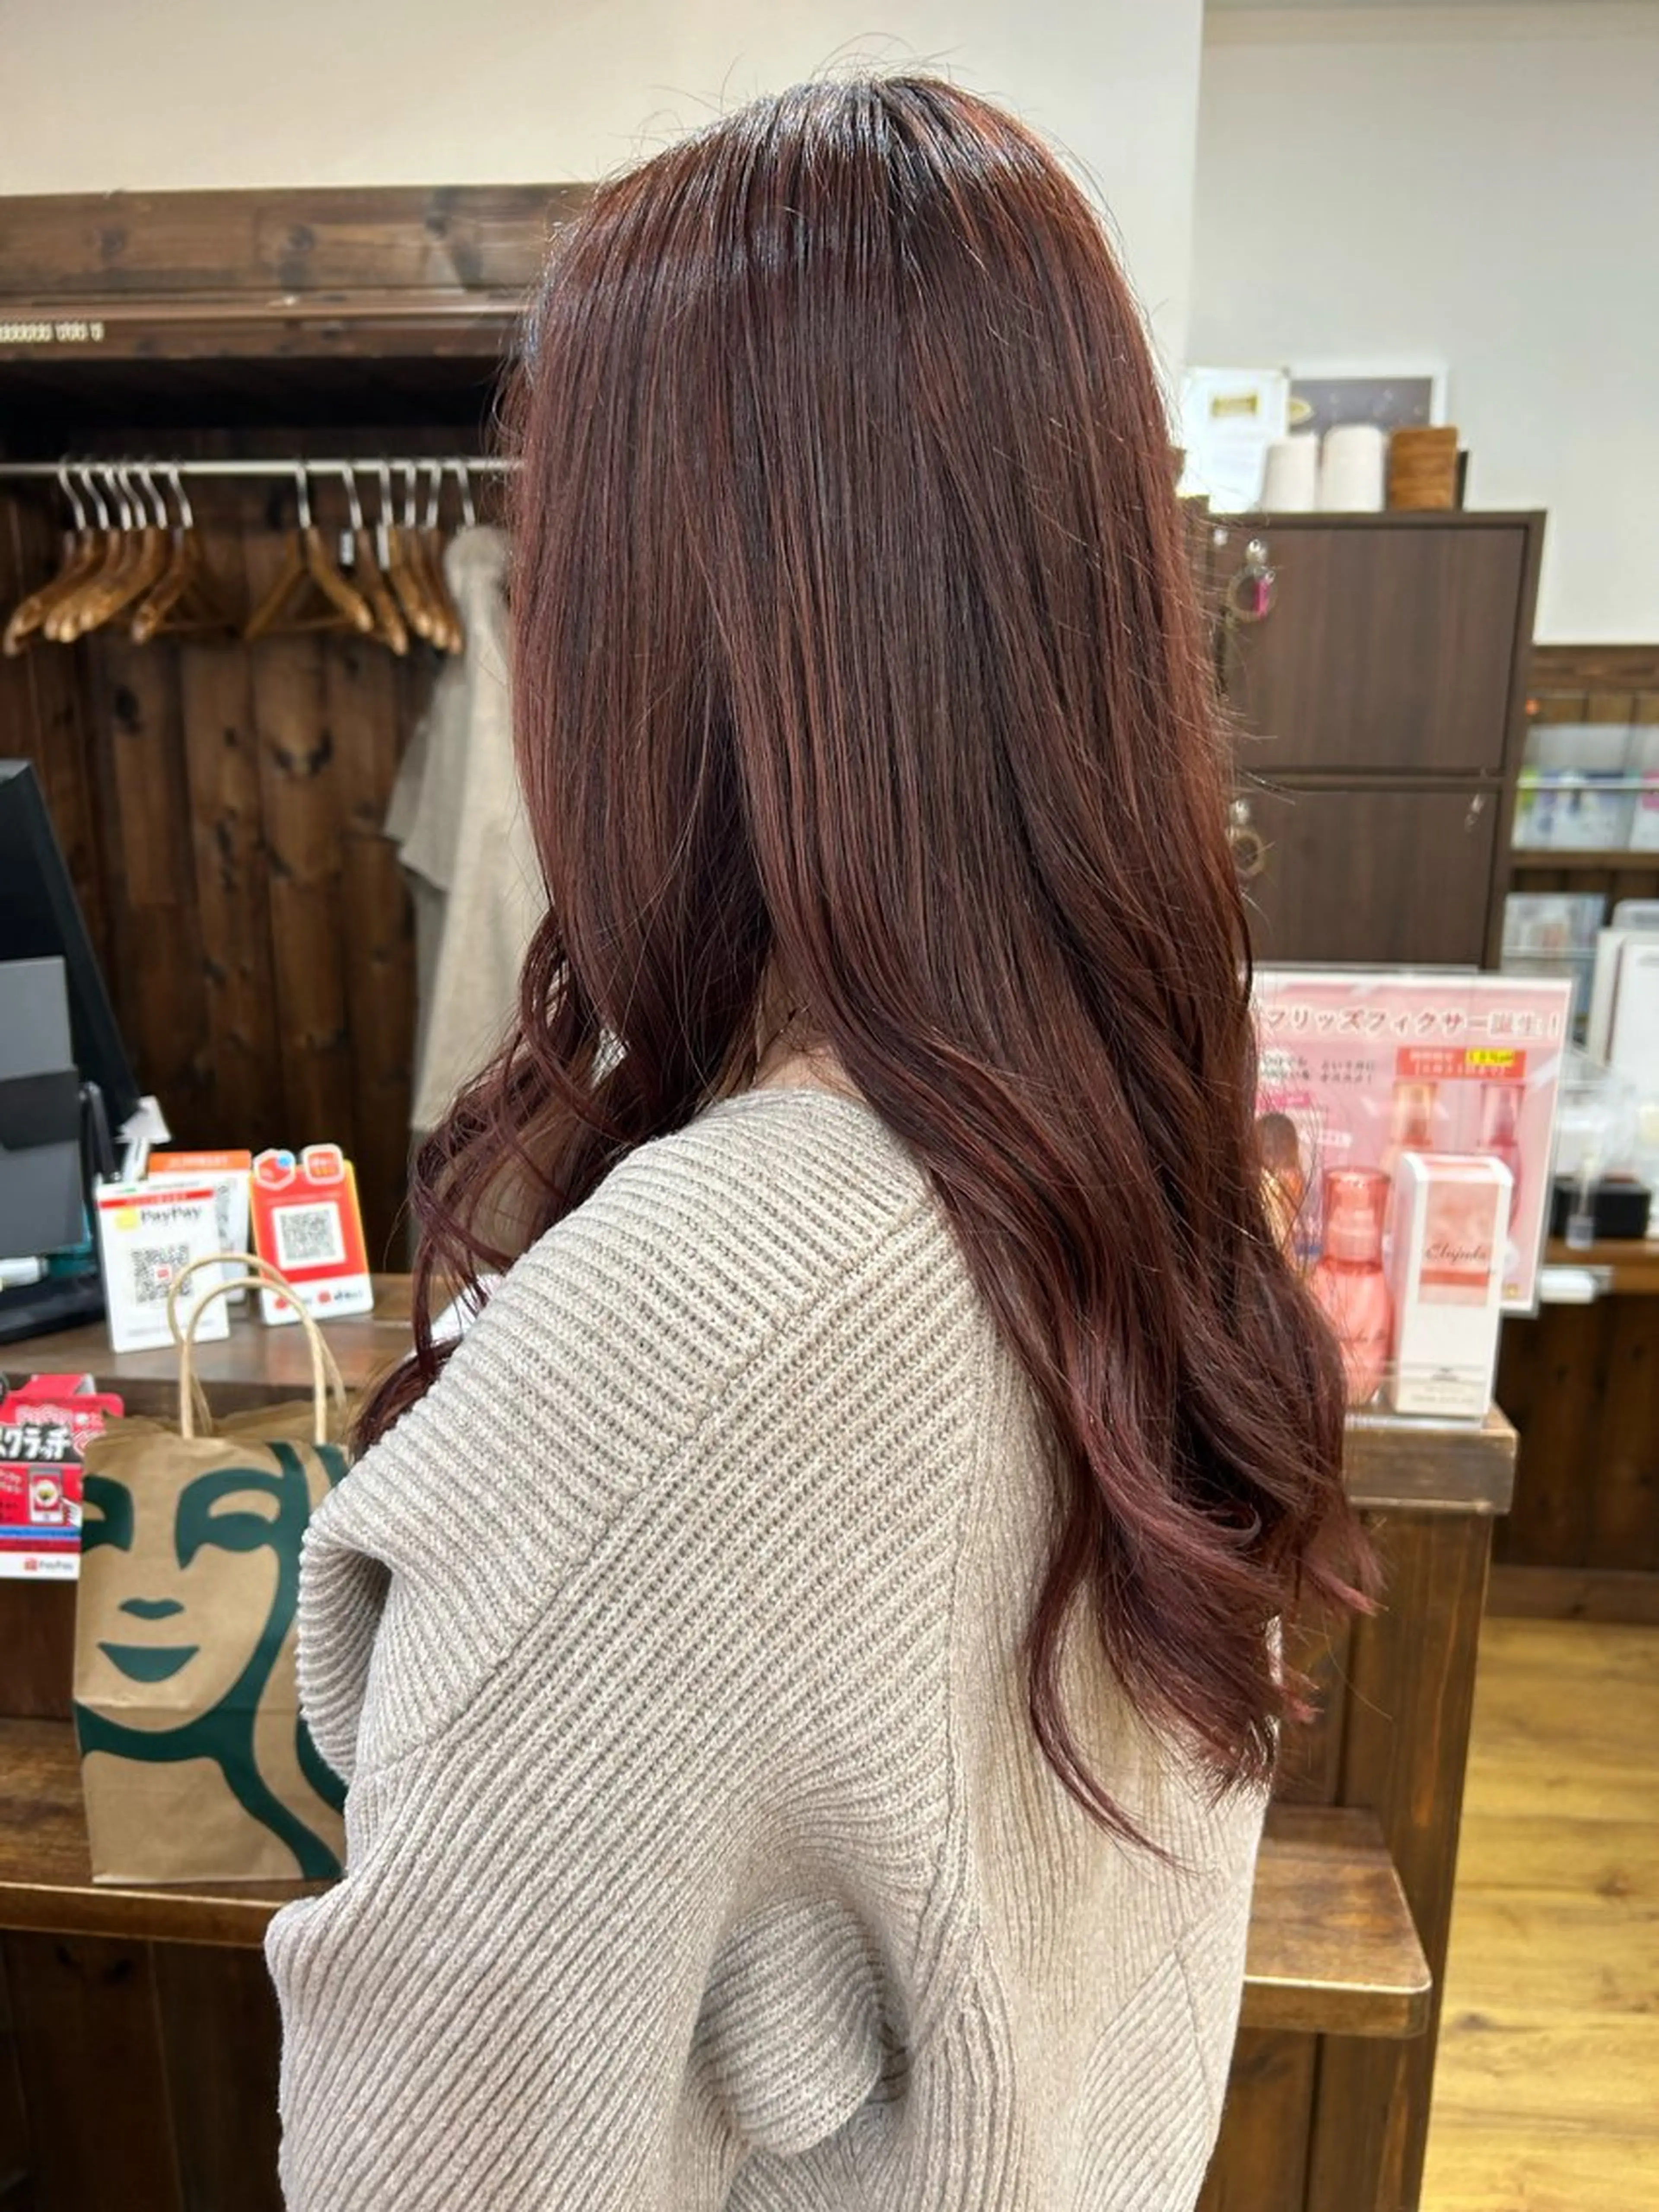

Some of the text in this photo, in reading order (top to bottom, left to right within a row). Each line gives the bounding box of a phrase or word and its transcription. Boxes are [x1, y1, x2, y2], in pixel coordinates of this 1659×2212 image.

[140, 1205, 201, 1224] PayPay
[0, 1426, 71, 1460] クラッチ
